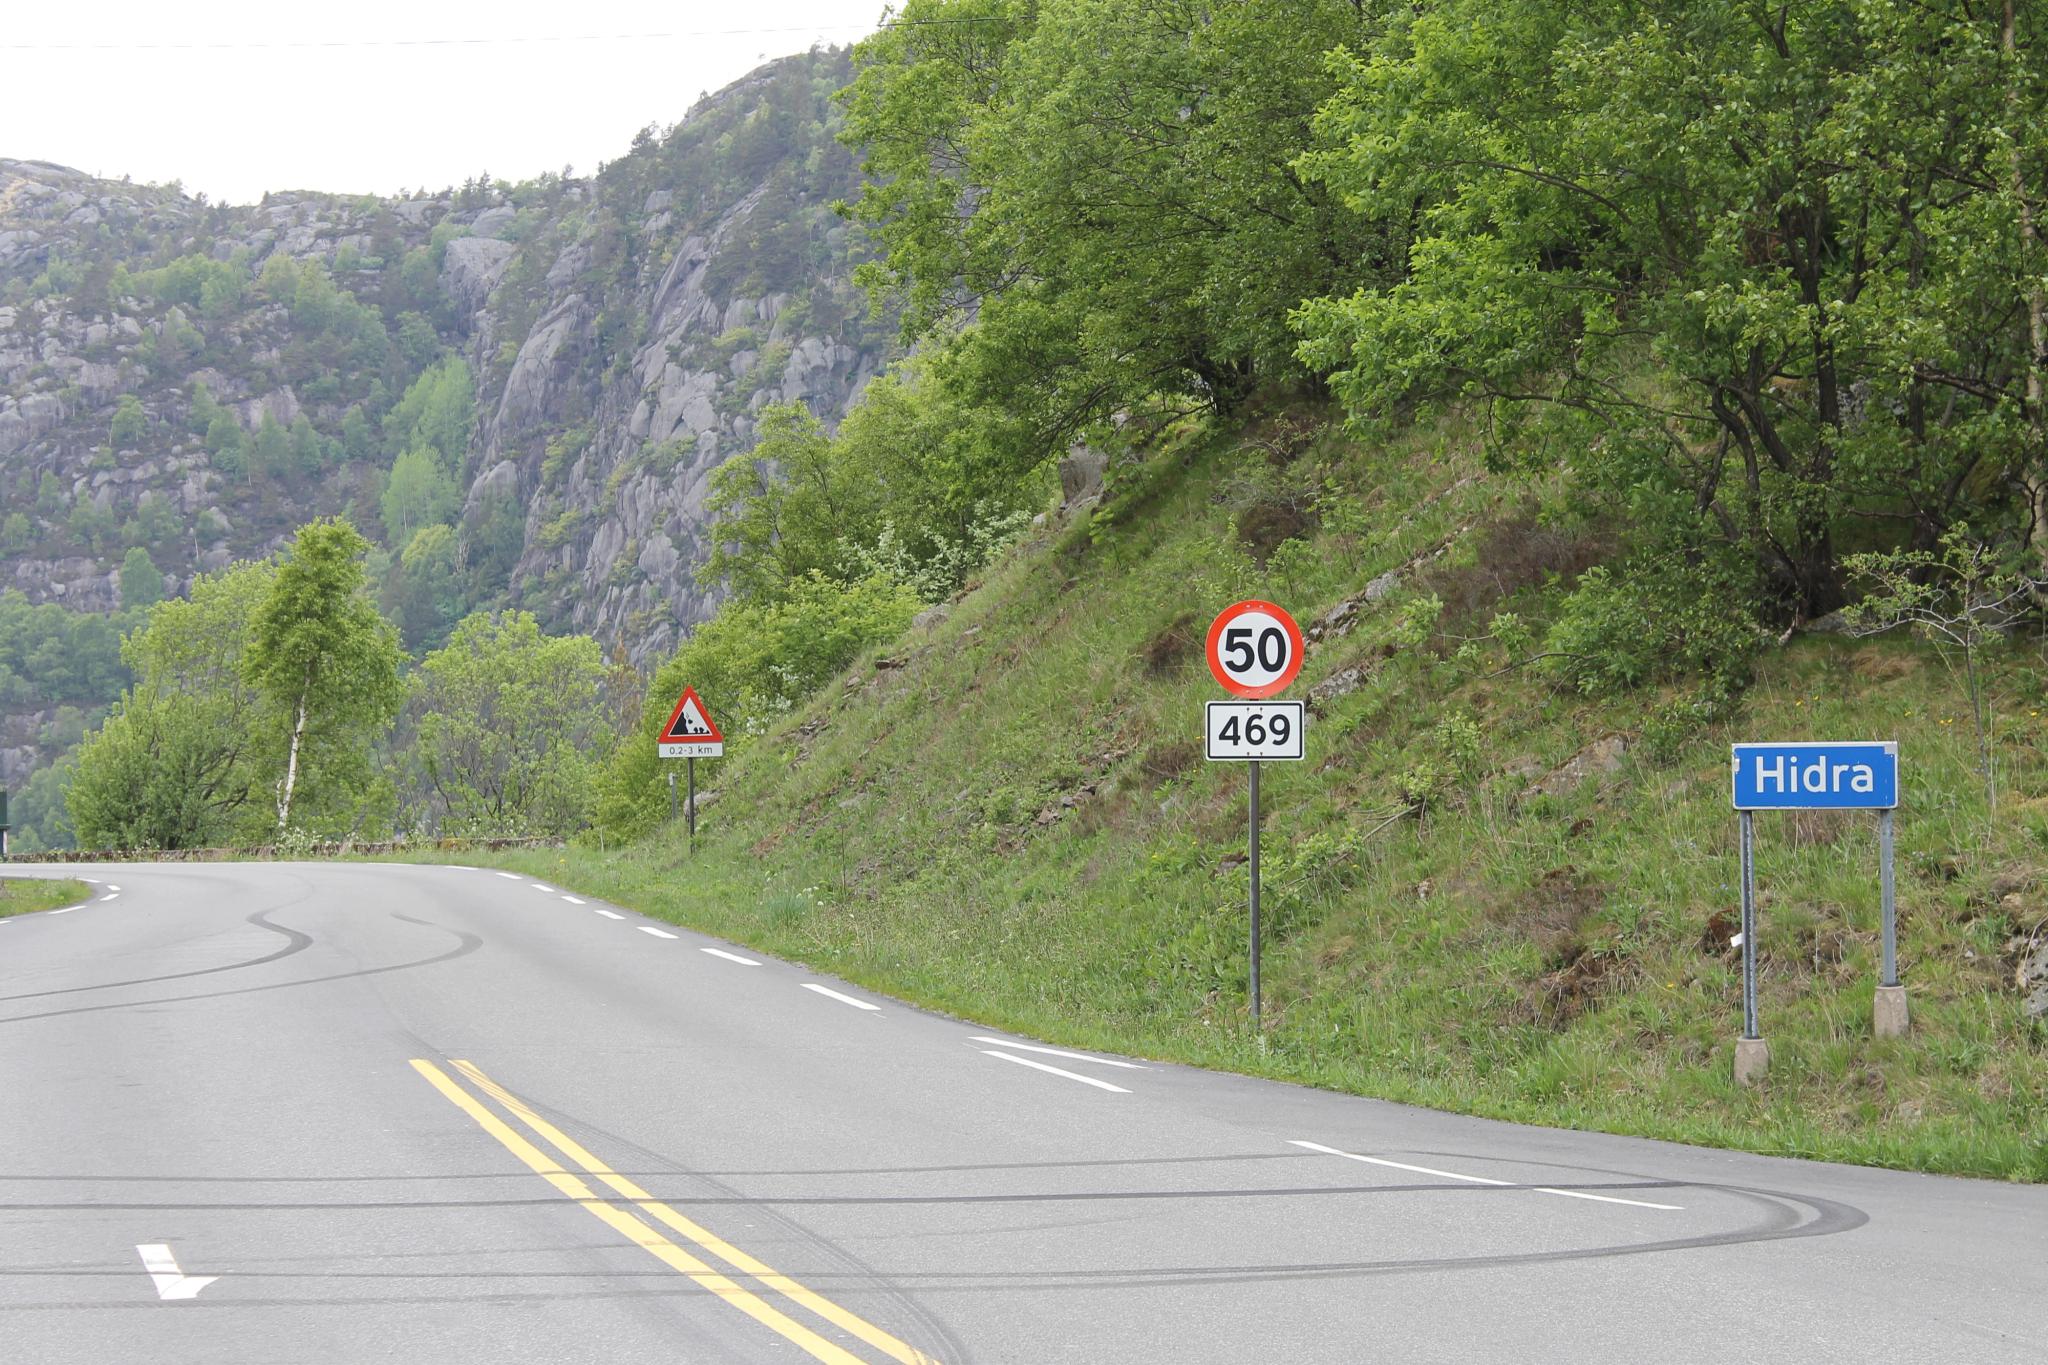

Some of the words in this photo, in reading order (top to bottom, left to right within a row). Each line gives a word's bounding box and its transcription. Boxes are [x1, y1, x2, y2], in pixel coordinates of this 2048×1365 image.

[1225, 627, 1286, 673] 50
[1218, 714, 1290, 746] 469
[698, 745, 713, 754] km
[1756, 756, 1873, 793] Hidra
